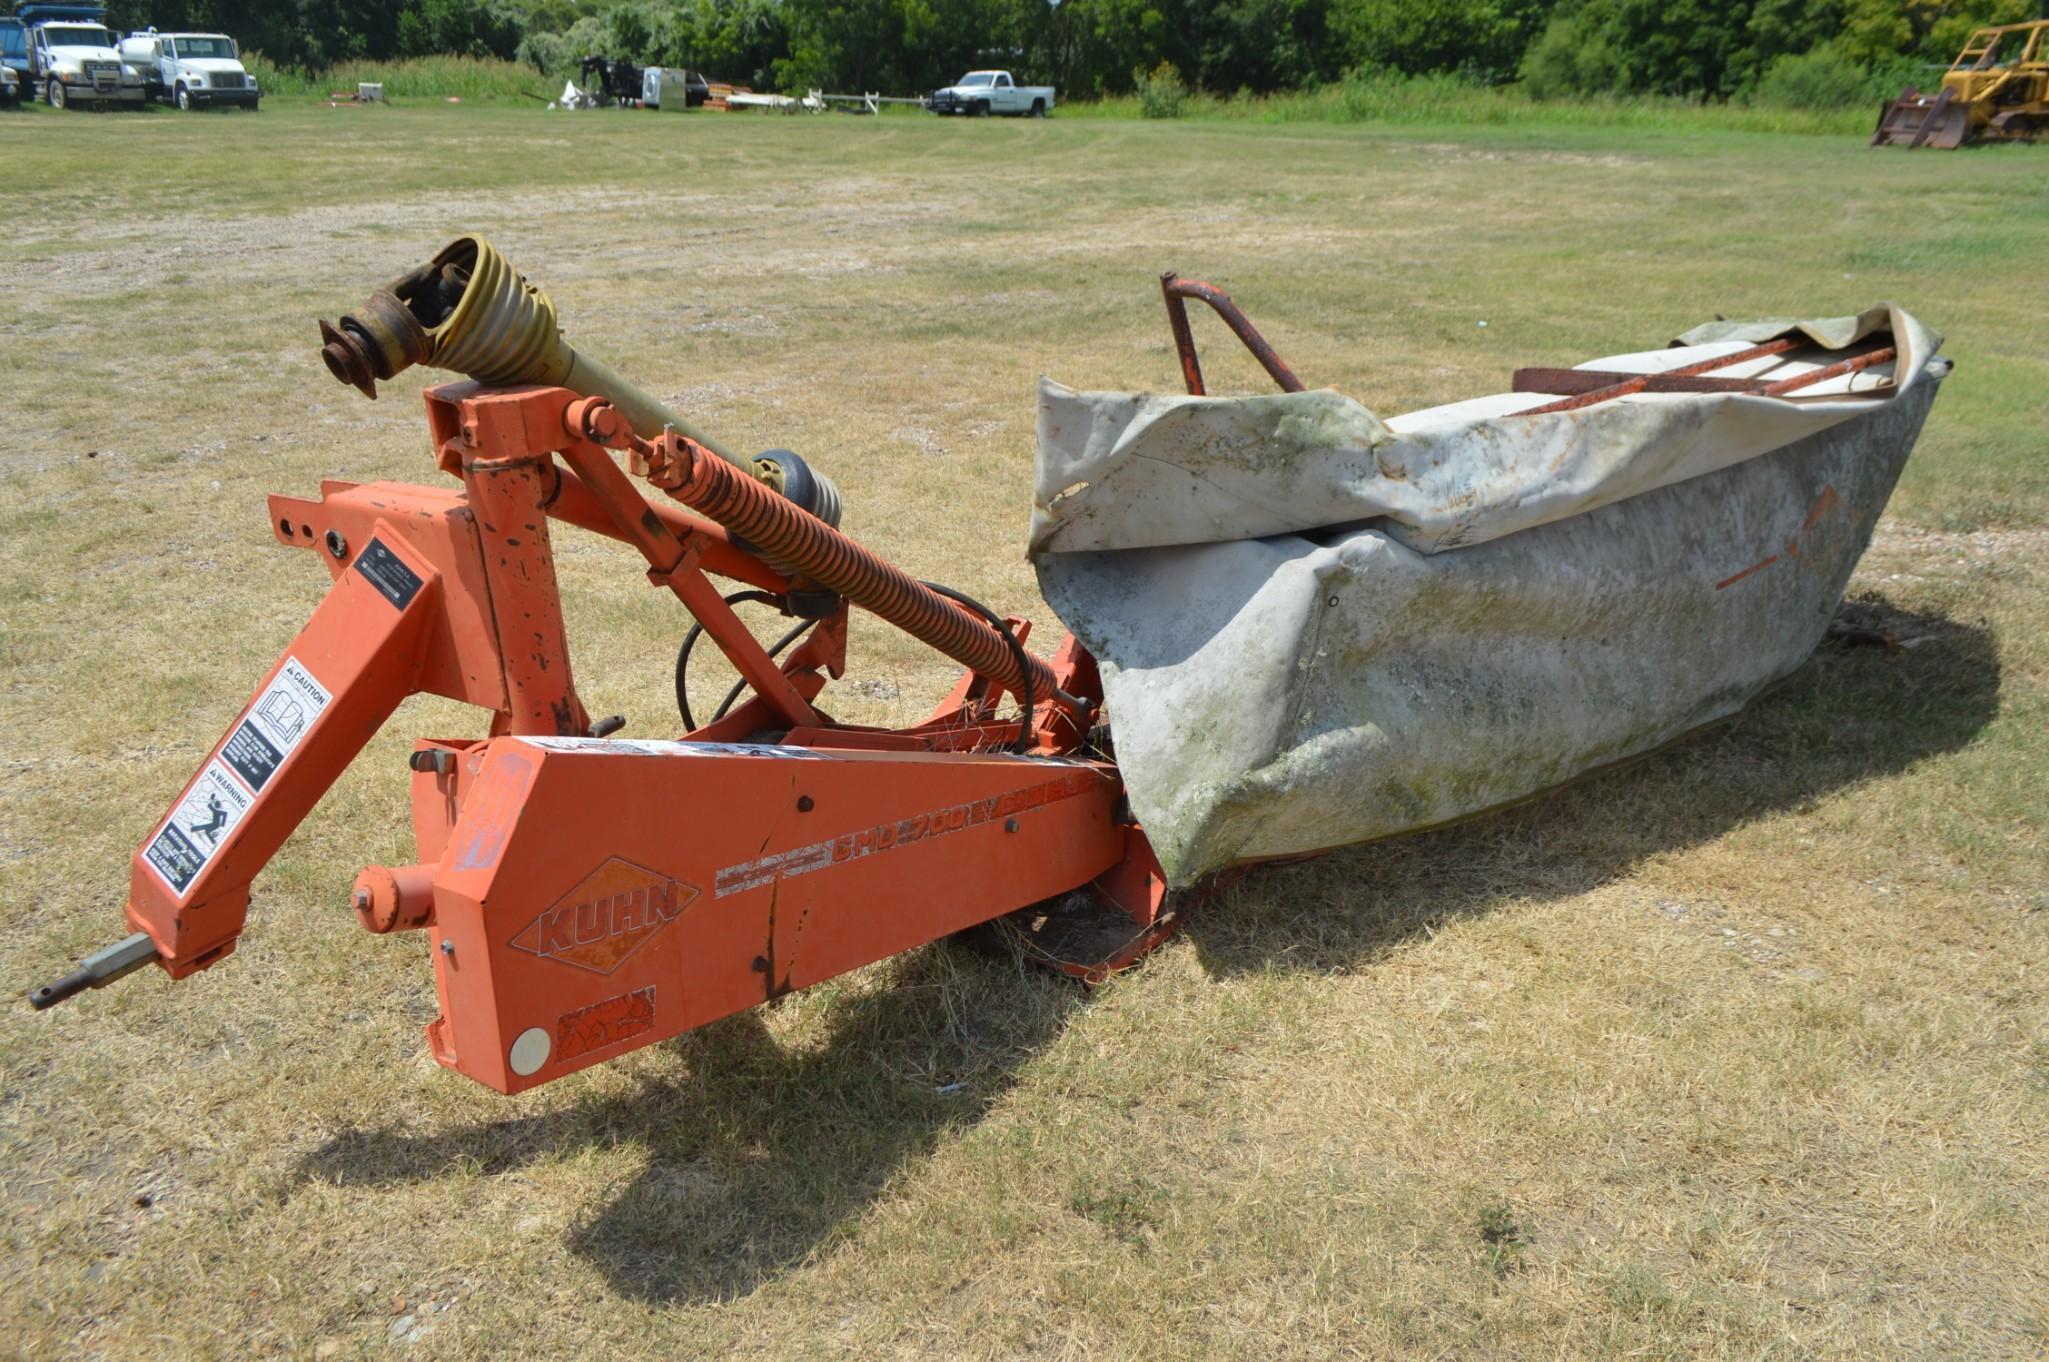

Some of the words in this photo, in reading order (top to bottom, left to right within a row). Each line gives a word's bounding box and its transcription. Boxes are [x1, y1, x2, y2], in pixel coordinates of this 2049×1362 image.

[294, 671, 326, 706] CAUTION
[215, 772, 248, 809] WARNING
[909, 806, 968, 840] 700
[537, 880, 679, 957] KUHN
